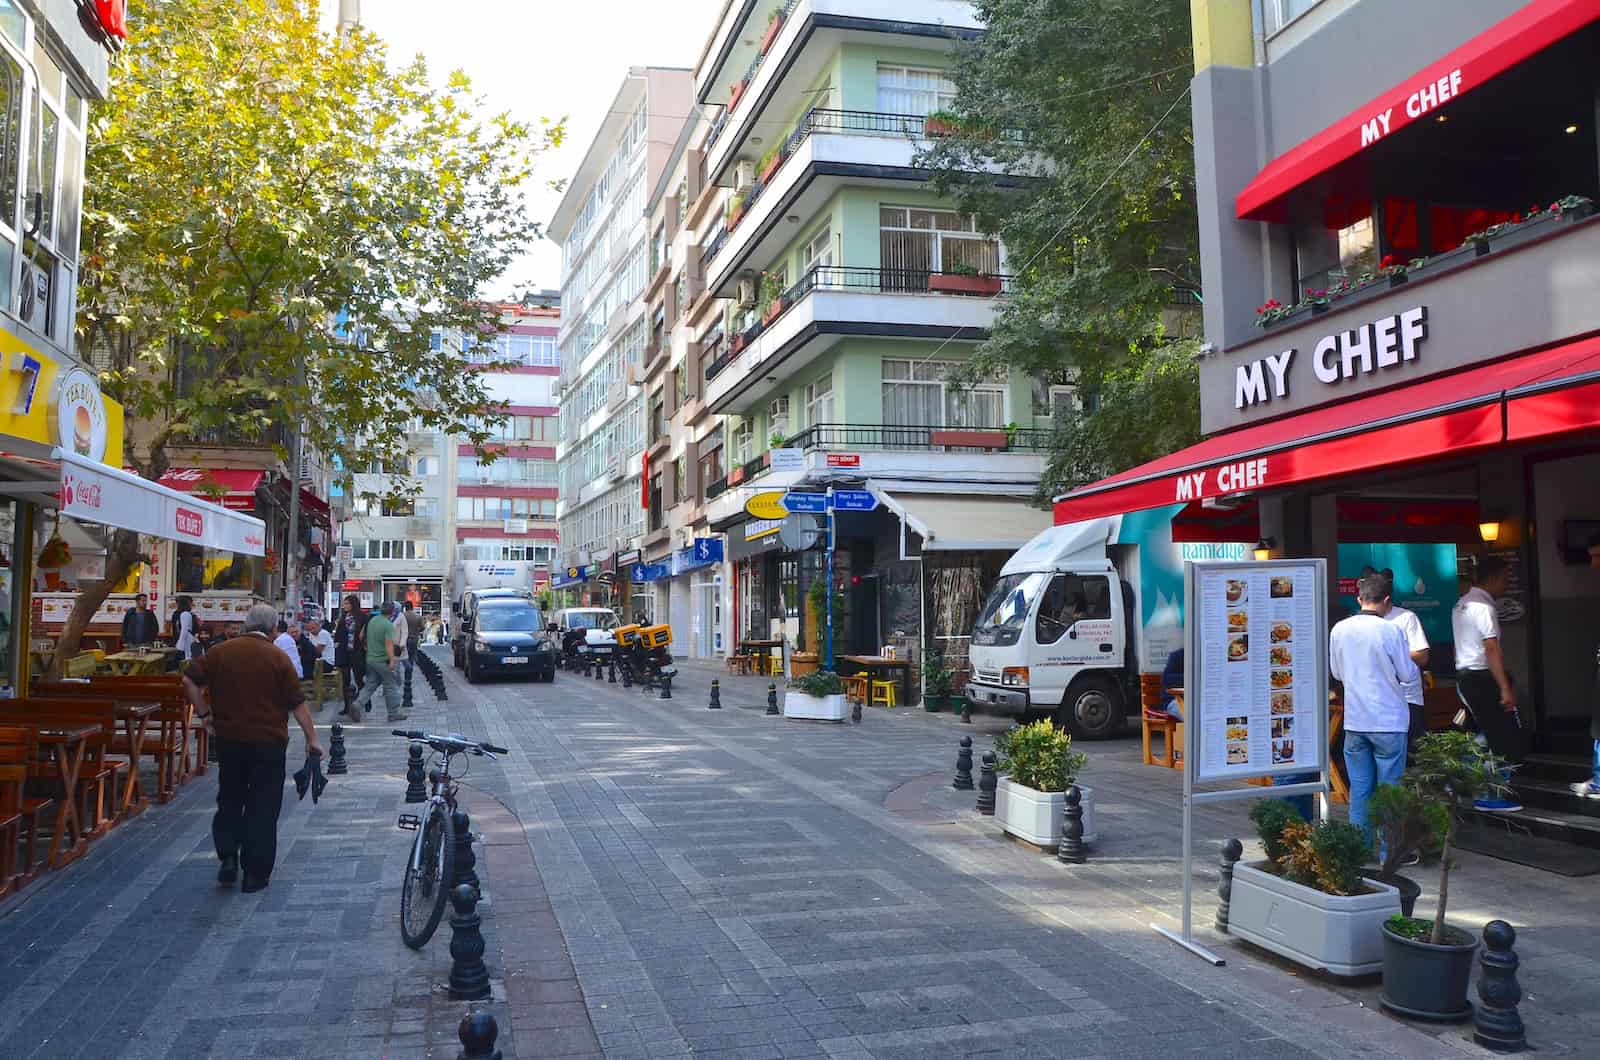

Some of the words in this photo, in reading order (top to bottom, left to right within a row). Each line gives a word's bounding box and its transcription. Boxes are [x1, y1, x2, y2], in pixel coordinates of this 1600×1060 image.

[1361, 109, 1393, 147] MY
[1406, 70, 1462, 118] CHEF
[1235, 349, 1295, 408] MY
[1312, 305, 1427, 384] CHEF
[1176, 472, 1206, 501] MY
[1217, 459, 1268, 491] CHEF
